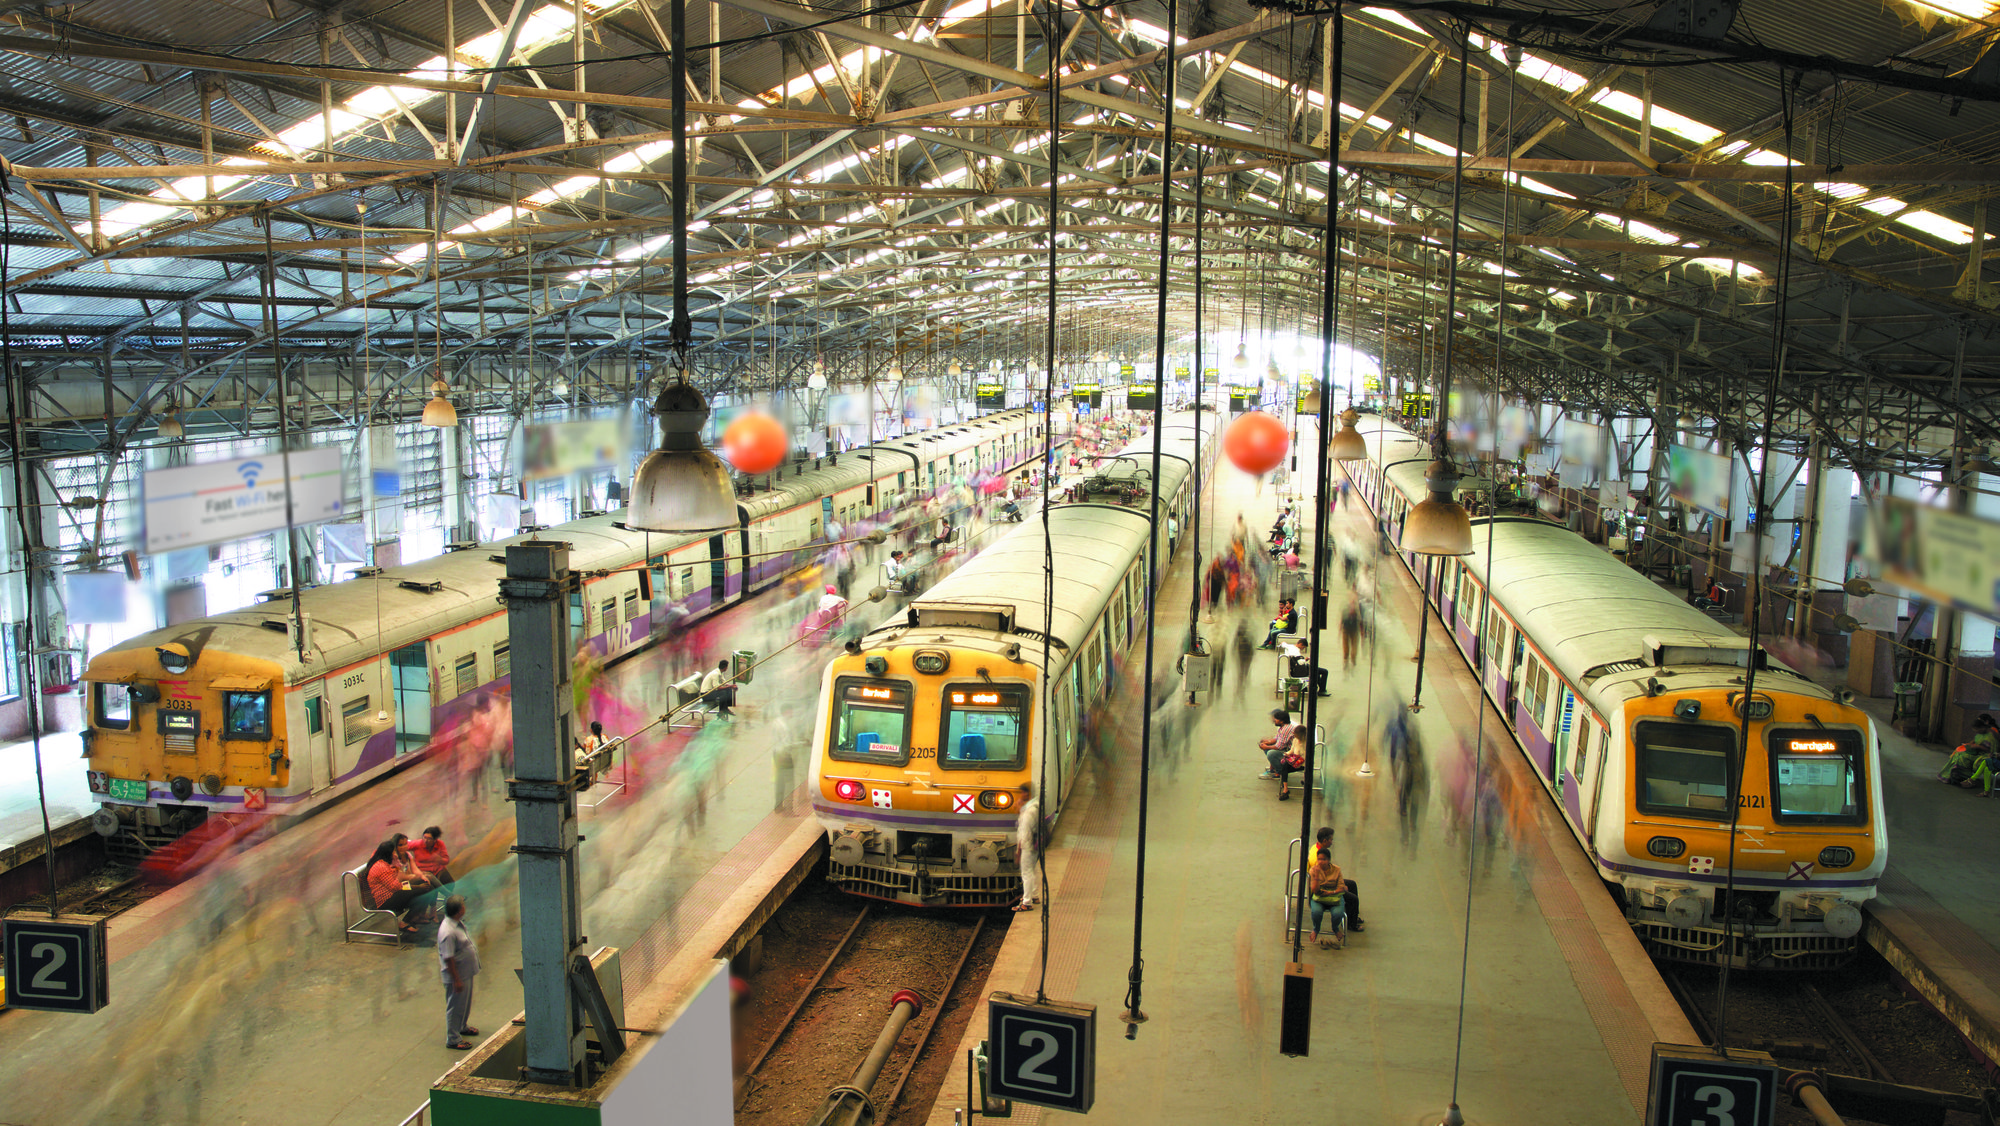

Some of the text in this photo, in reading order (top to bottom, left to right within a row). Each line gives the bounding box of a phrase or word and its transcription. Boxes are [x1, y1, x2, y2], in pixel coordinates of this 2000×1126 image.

[206, 490, 288, 511] Fast Wi-Fi her
[606, 621, 632, 654] WR
[343, 672, 365, 689] 3033C
[166, 699, 193, 711] 3033
[871, 744, 898, 752] BORIVALI
[910, 747, 936, 759] 2205
[1790, 741, 1836, 752] Churchgate
[1739, 794, 1765, 808] 2121
[31, 942, 67, 990] 2
[1017, 1030, 1059, 1085] 2
[1691, 1085, 1735, 1126] 3
